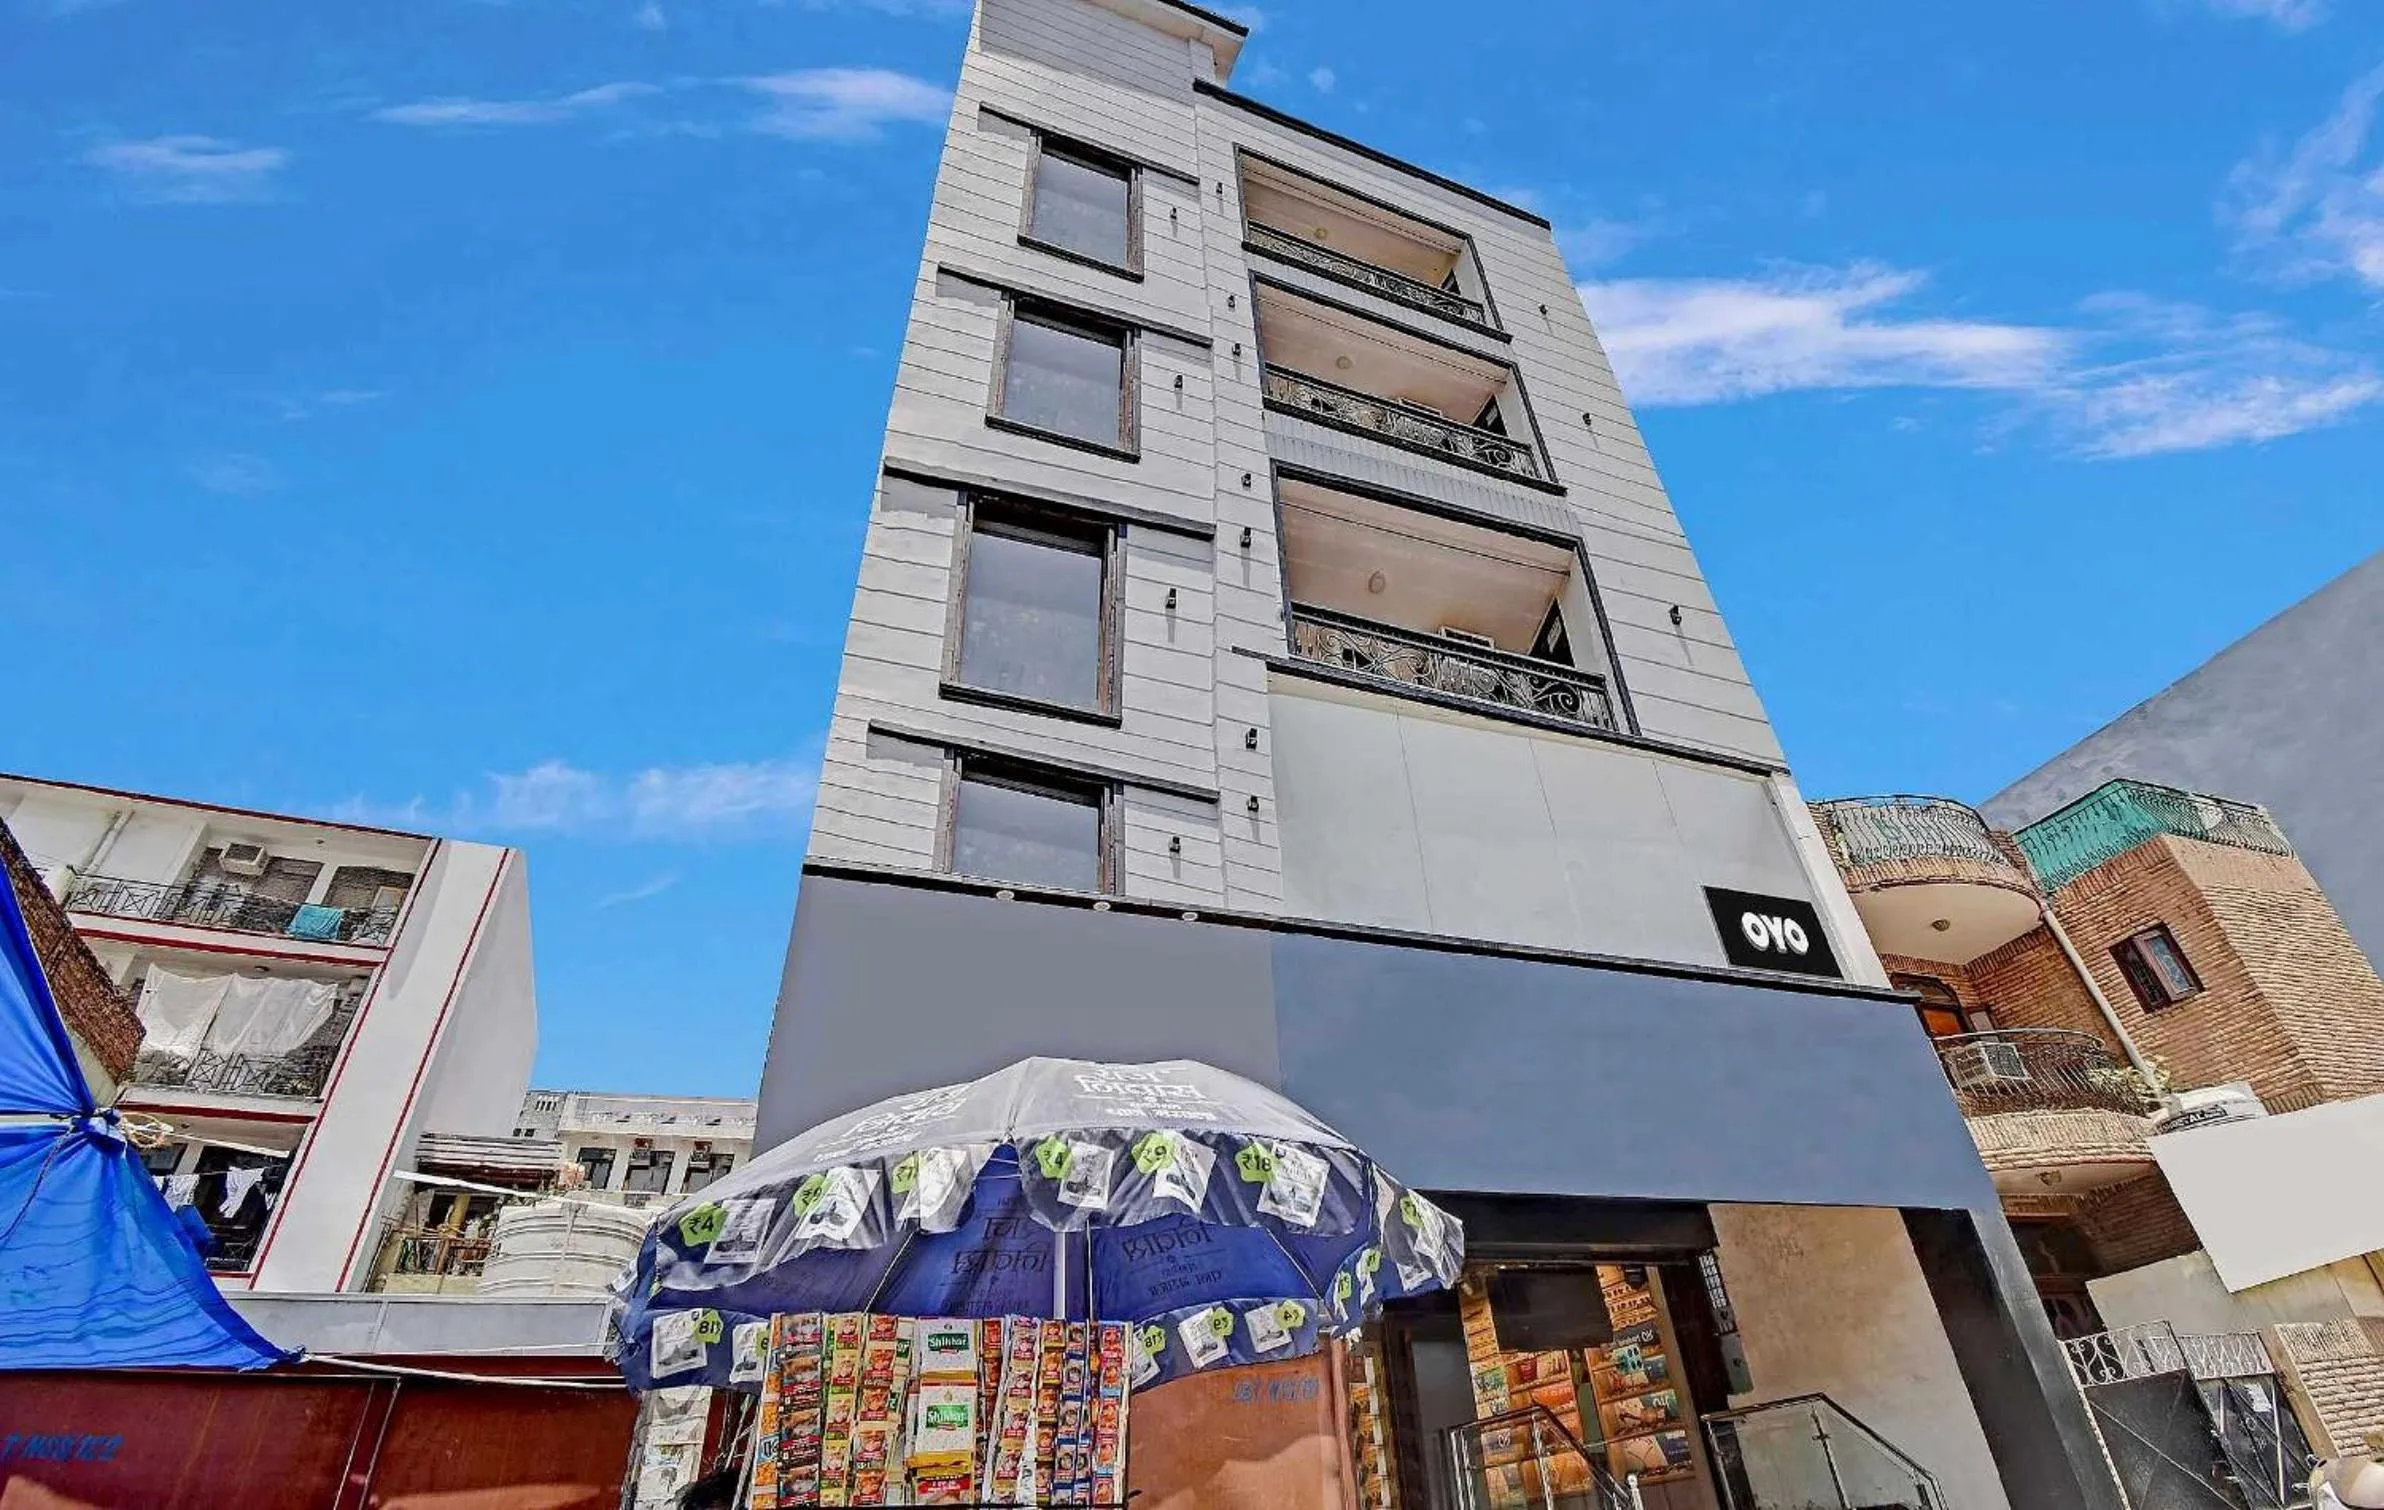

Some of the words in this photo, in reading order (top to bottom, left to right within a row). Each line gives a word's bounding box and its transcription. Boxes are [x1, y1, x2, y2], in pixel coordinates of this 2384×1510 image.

[1741, 911, 1809, 956] OYO
[1043, 1149, 1064, 1169] ₹4
[1143, 1145, 1167, 1164] ₹9
[1242, 1153, 1272, 1172] ₹18
[687, 1215, 714, 1235] ₹4
[929, 1335, 967, 1348] Shikhar
